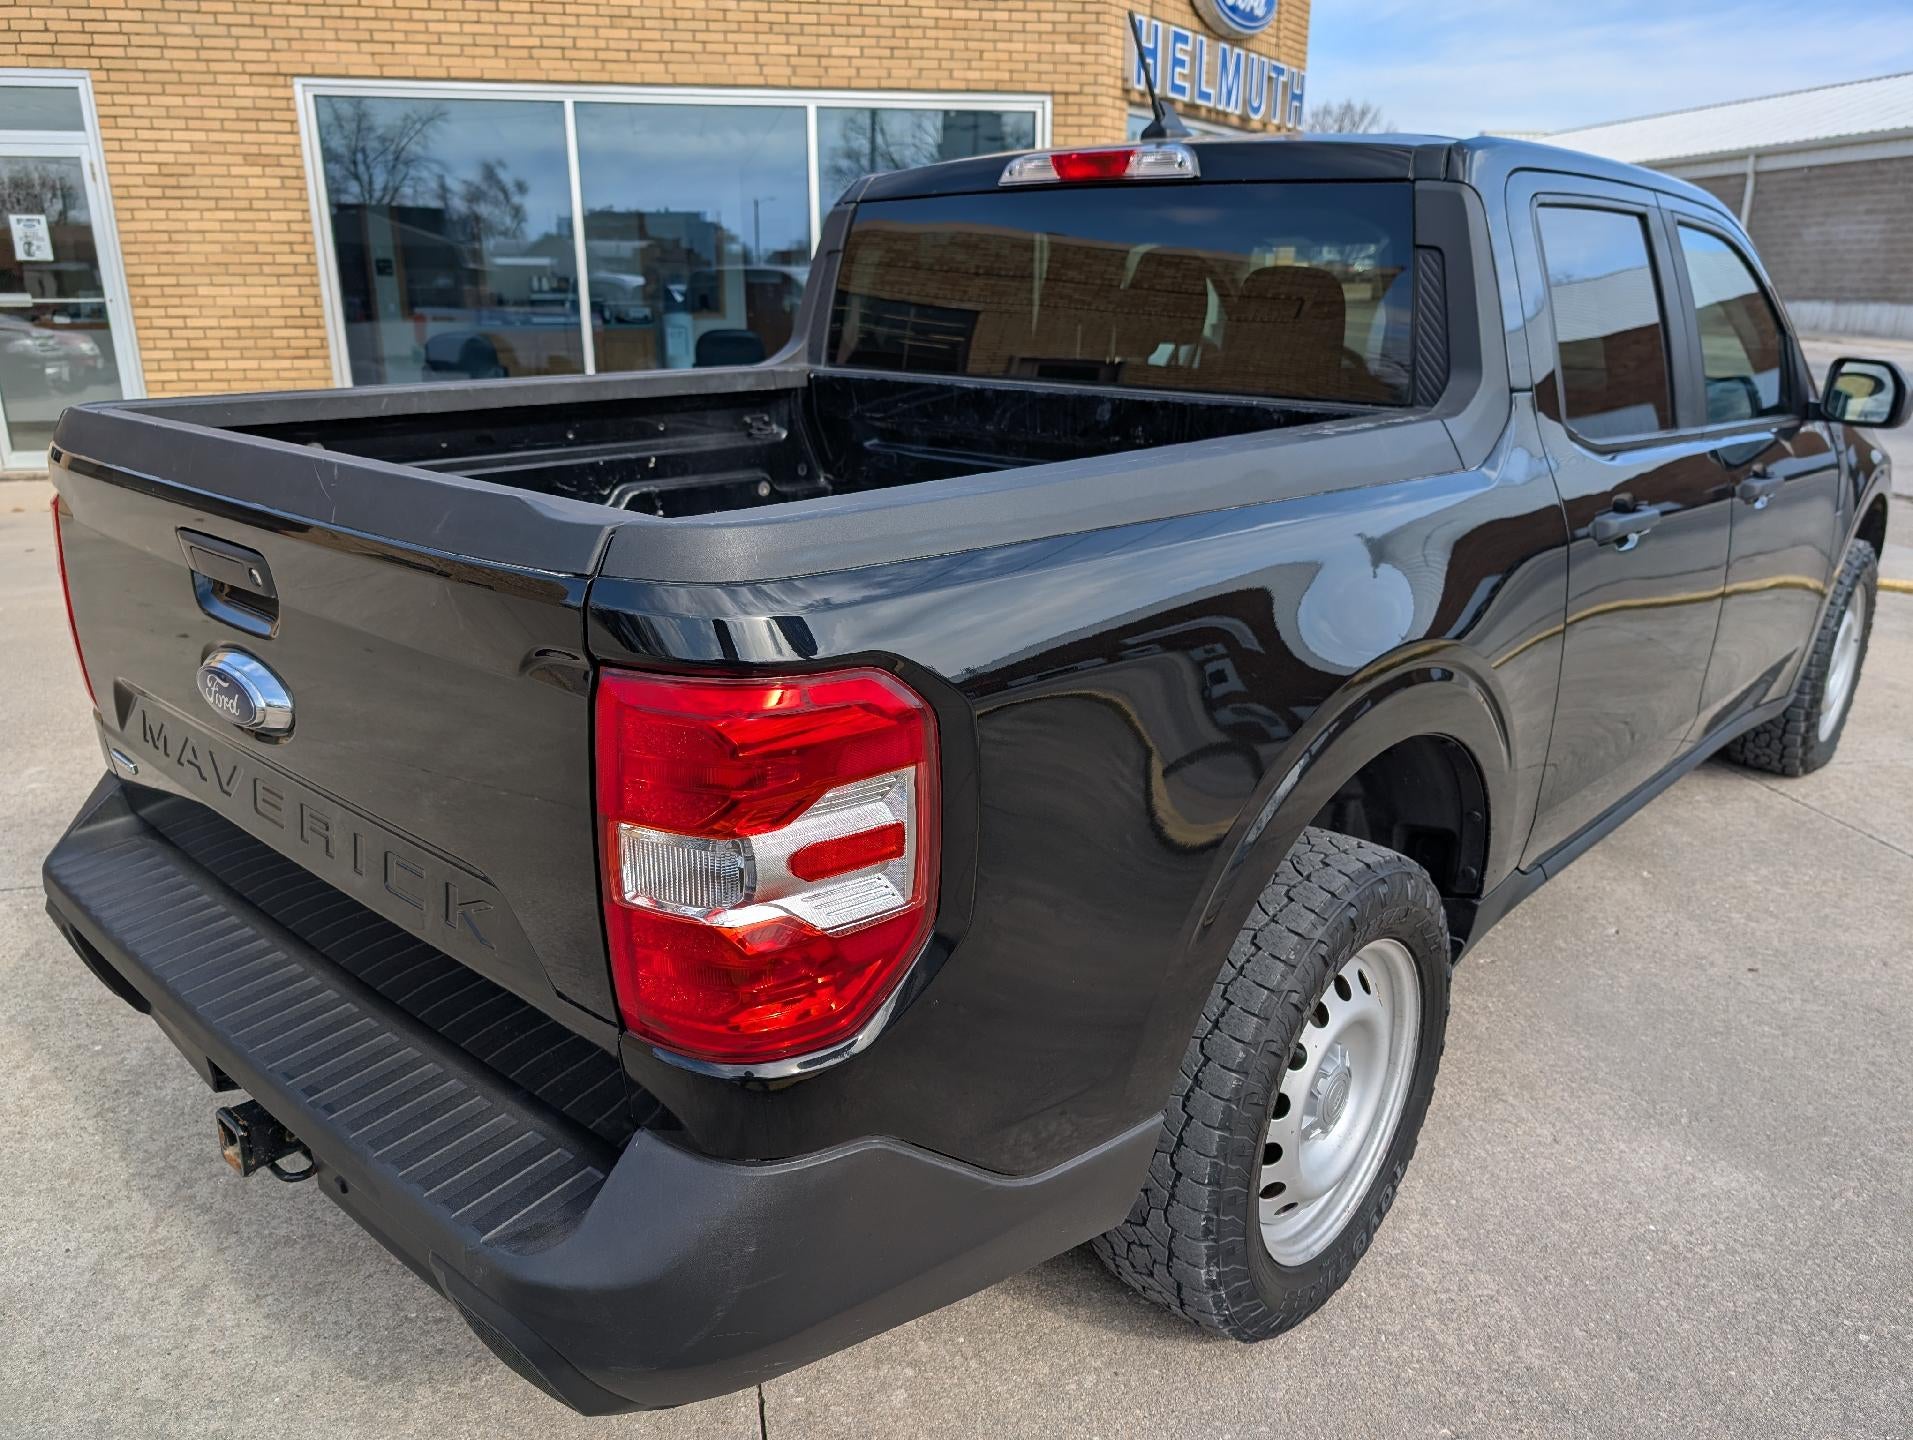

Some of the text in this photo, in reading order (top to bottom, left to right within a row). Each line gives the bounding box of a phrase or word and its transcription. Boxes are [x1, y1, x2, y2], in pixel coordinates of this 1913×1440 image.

[1133, 14, 1306, 130] HELMUTH
[205, 673, 241, 716] Ford
[141, 707, 497, 951] MAVERICK
